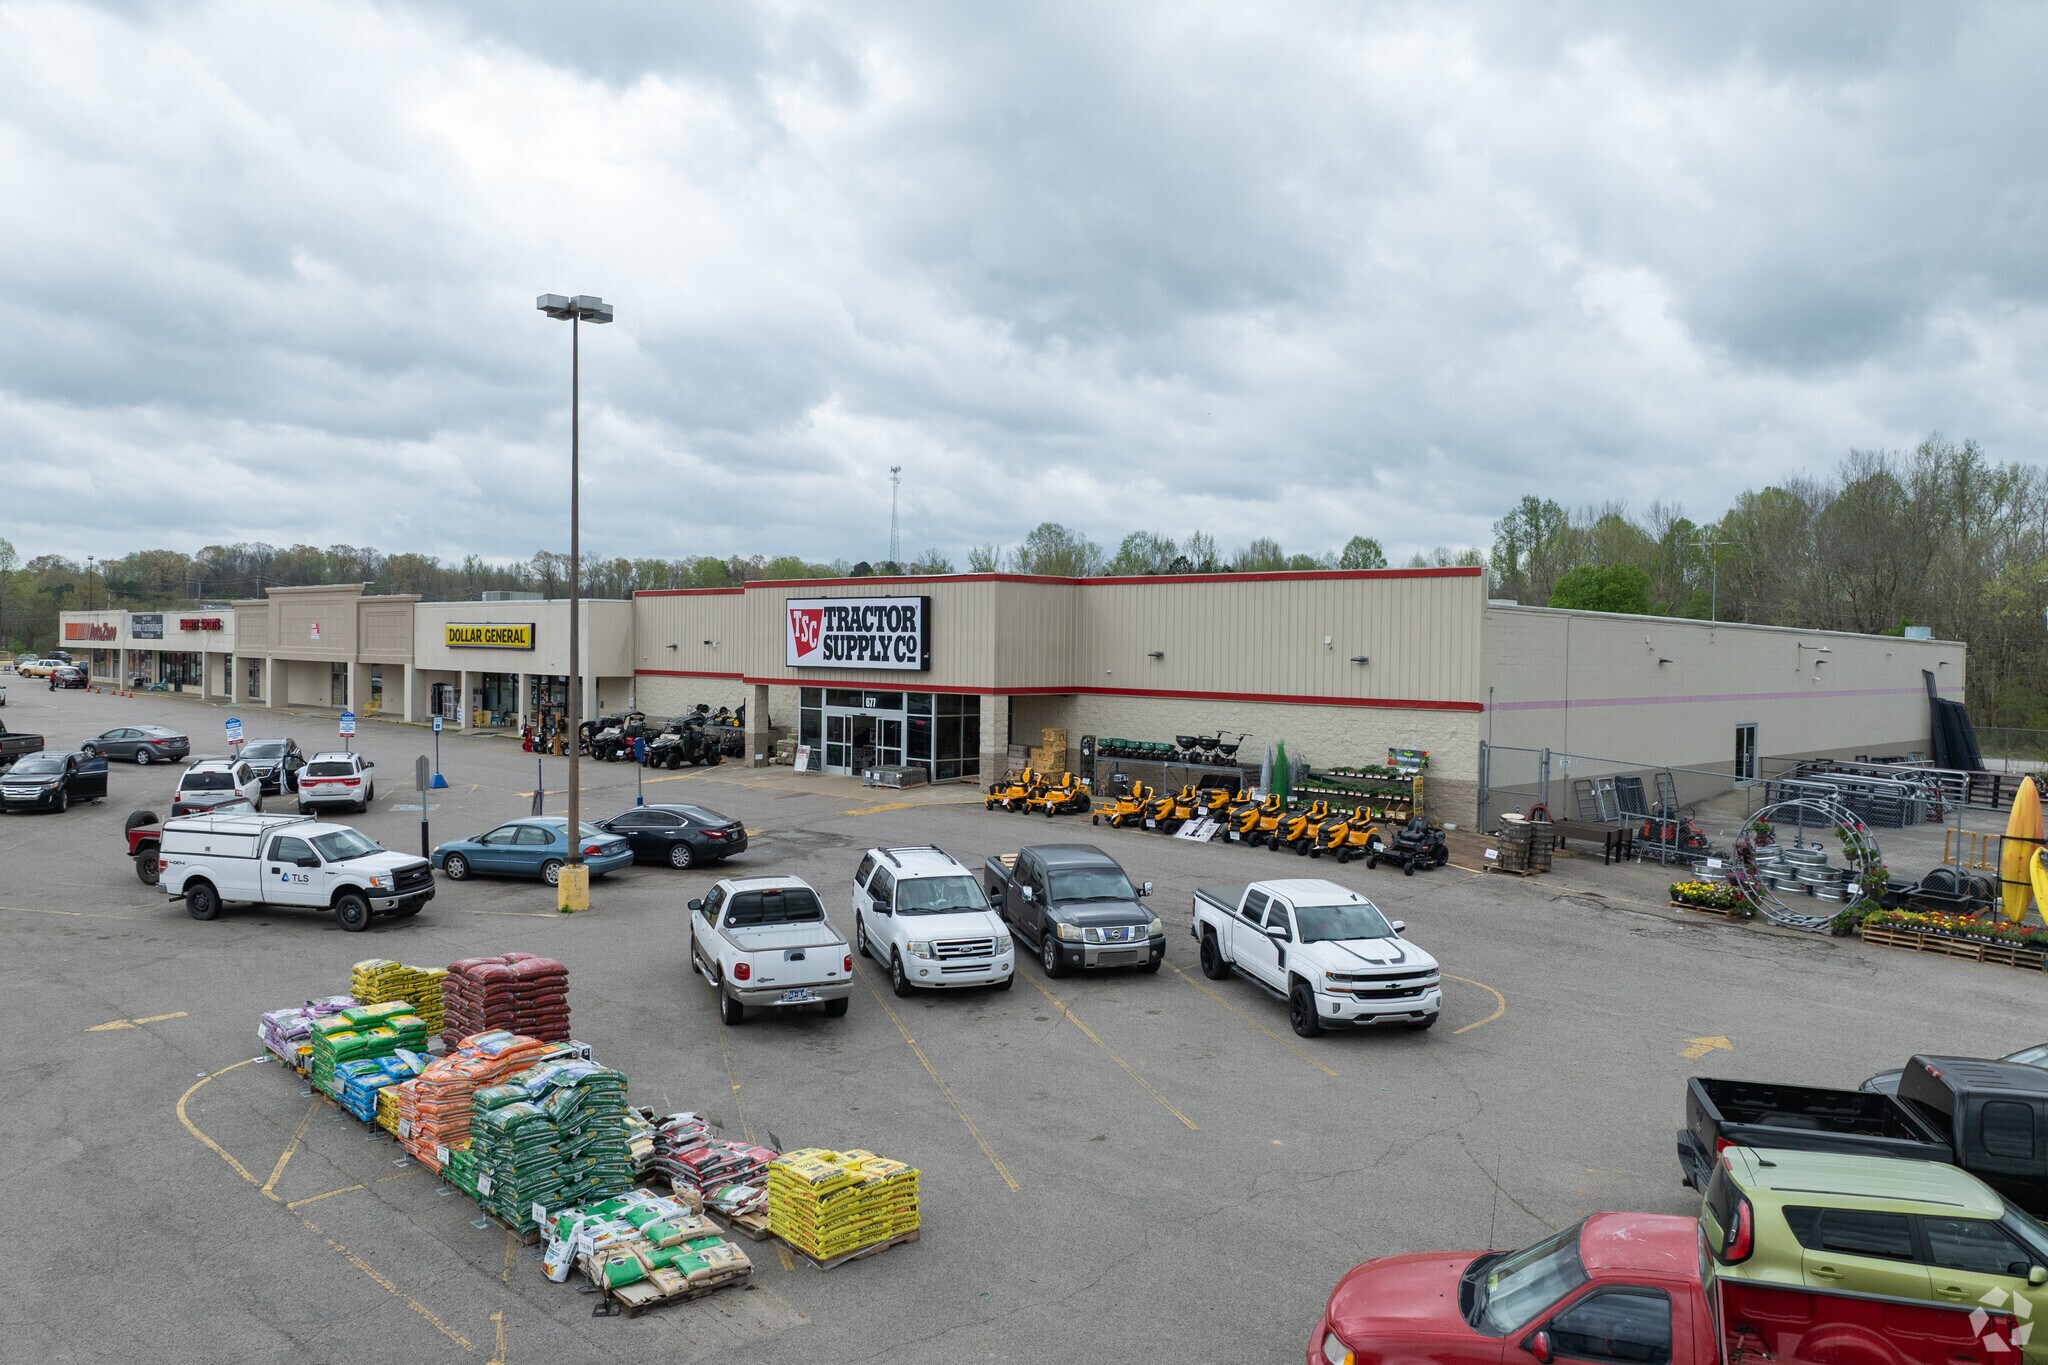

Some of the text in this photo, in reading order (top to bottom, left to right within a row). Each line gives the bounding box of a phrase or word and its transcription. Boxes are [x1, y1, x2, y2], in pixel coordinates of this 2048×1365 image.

[793, 610, 818, 648] TSC
[823, 605, 917, 633] TRACTOR
[449, 628, 526, 644] DOLLAR GENERAL
[823, 634, 893, 662] SUPPLY
[865, 697, 877, 708] 677
[291, 873, 309, 883] TLS
